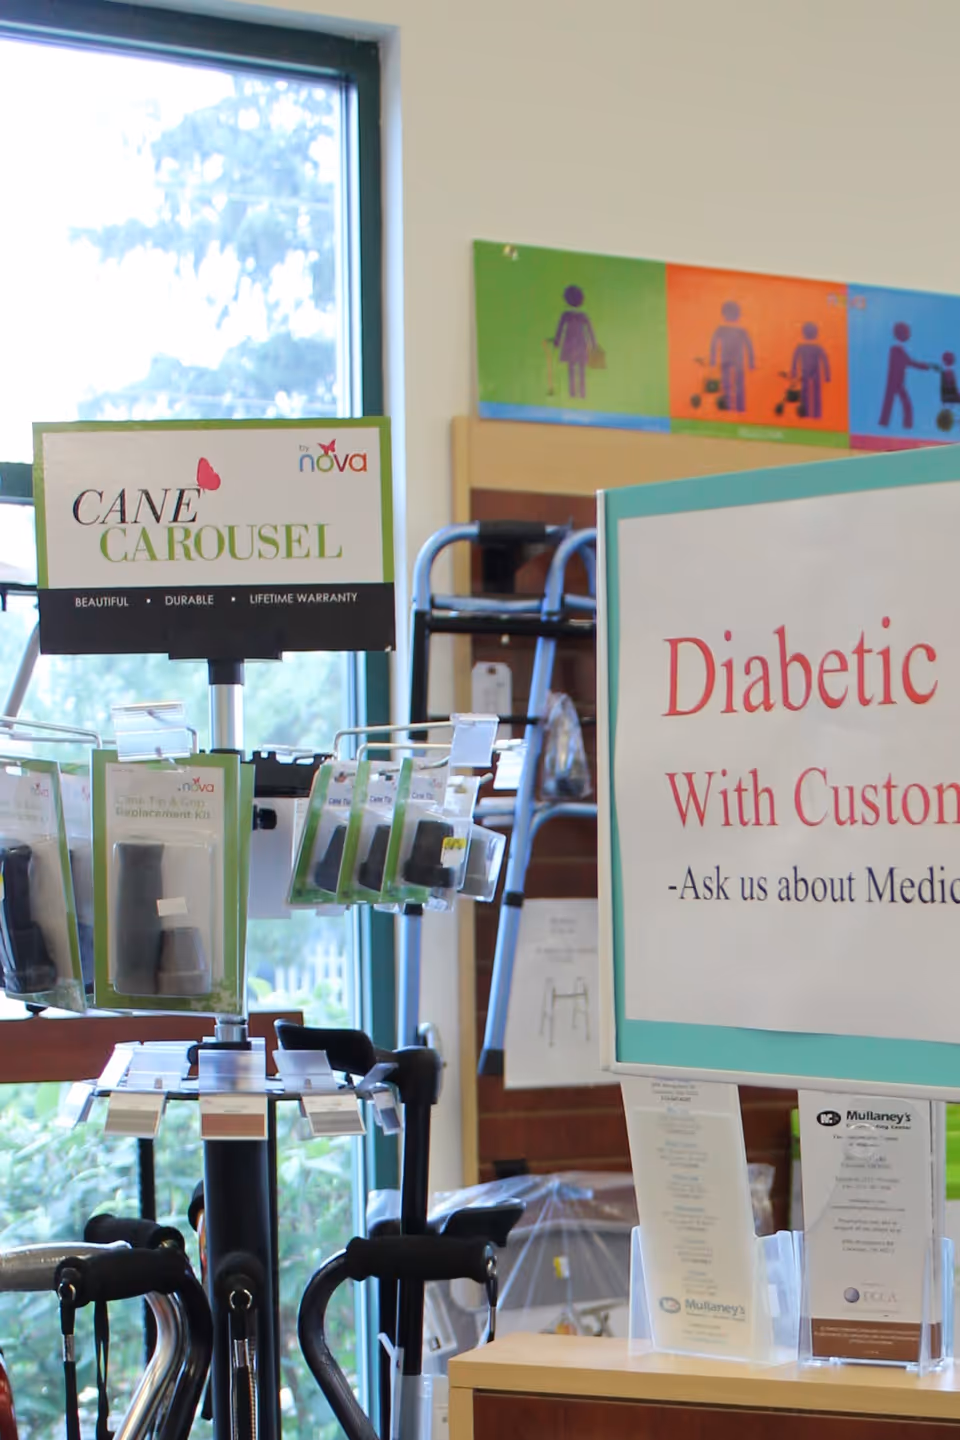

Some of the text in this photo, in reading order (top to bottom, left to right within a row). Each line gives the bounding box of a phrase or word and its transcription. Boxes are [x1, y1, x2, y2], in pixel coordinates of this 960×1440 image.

[299, 453, 367, 473] nova
[72, 488, 201, 525] CANE
[99, 523, 343, 562] CAROUSEL
[75, 592, 358, 608] BEAUTIFUL DURABLE LIFETIME WARRANTY
[662, 616, 938, 717] Diabetic
[665, 767, 779, 828] With
[667, 865, 730, 902] -Ask
[740, 876, 768, 902] us
[778, 866, 855, 903] about
[846, 1110, 911, 1124] Mullaney's
